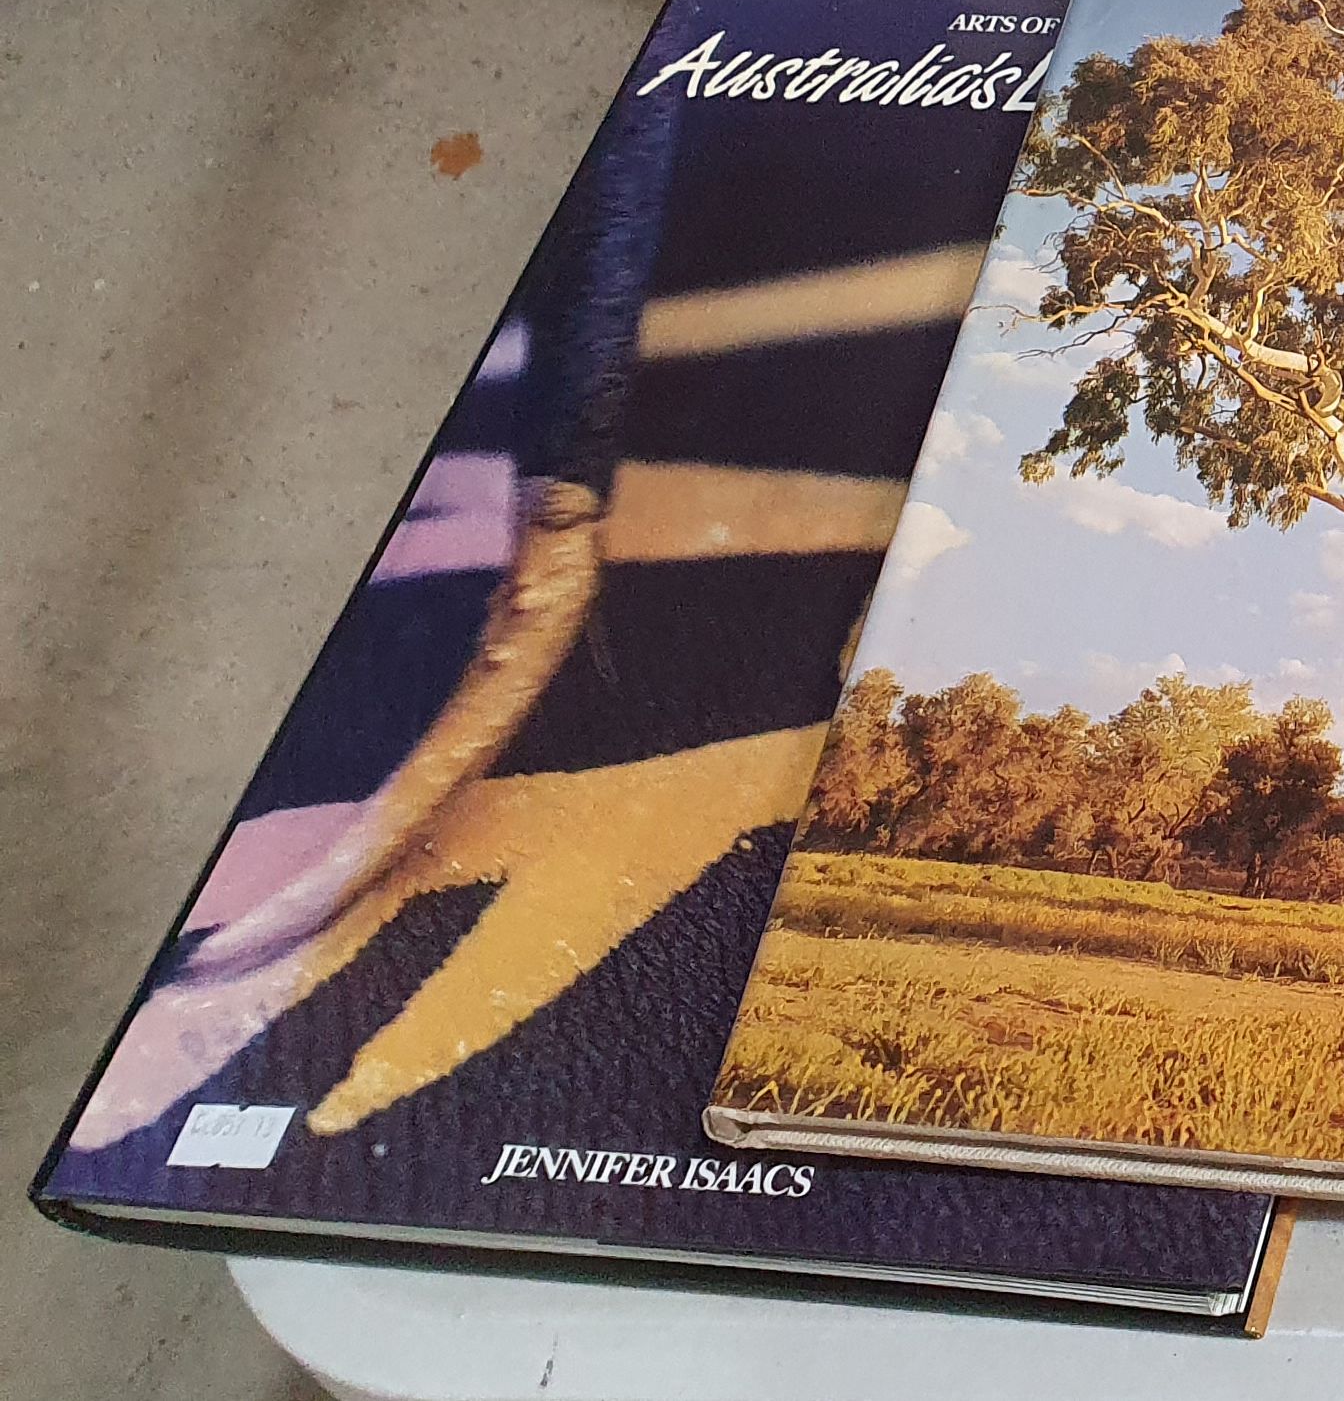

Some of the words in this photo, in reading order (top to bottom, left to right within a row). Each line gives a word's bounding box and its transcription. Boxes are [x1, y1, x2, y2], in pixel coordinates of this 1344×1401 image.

[948, 13, 1016, 33] ARTS
[1020, 16, 1060, 35] OF
[636, 30, 1012, 111] Australia's
[480, 1144, 677, 1190] JENNIFER
[679, 1157, 815, 1198] ISAACS
